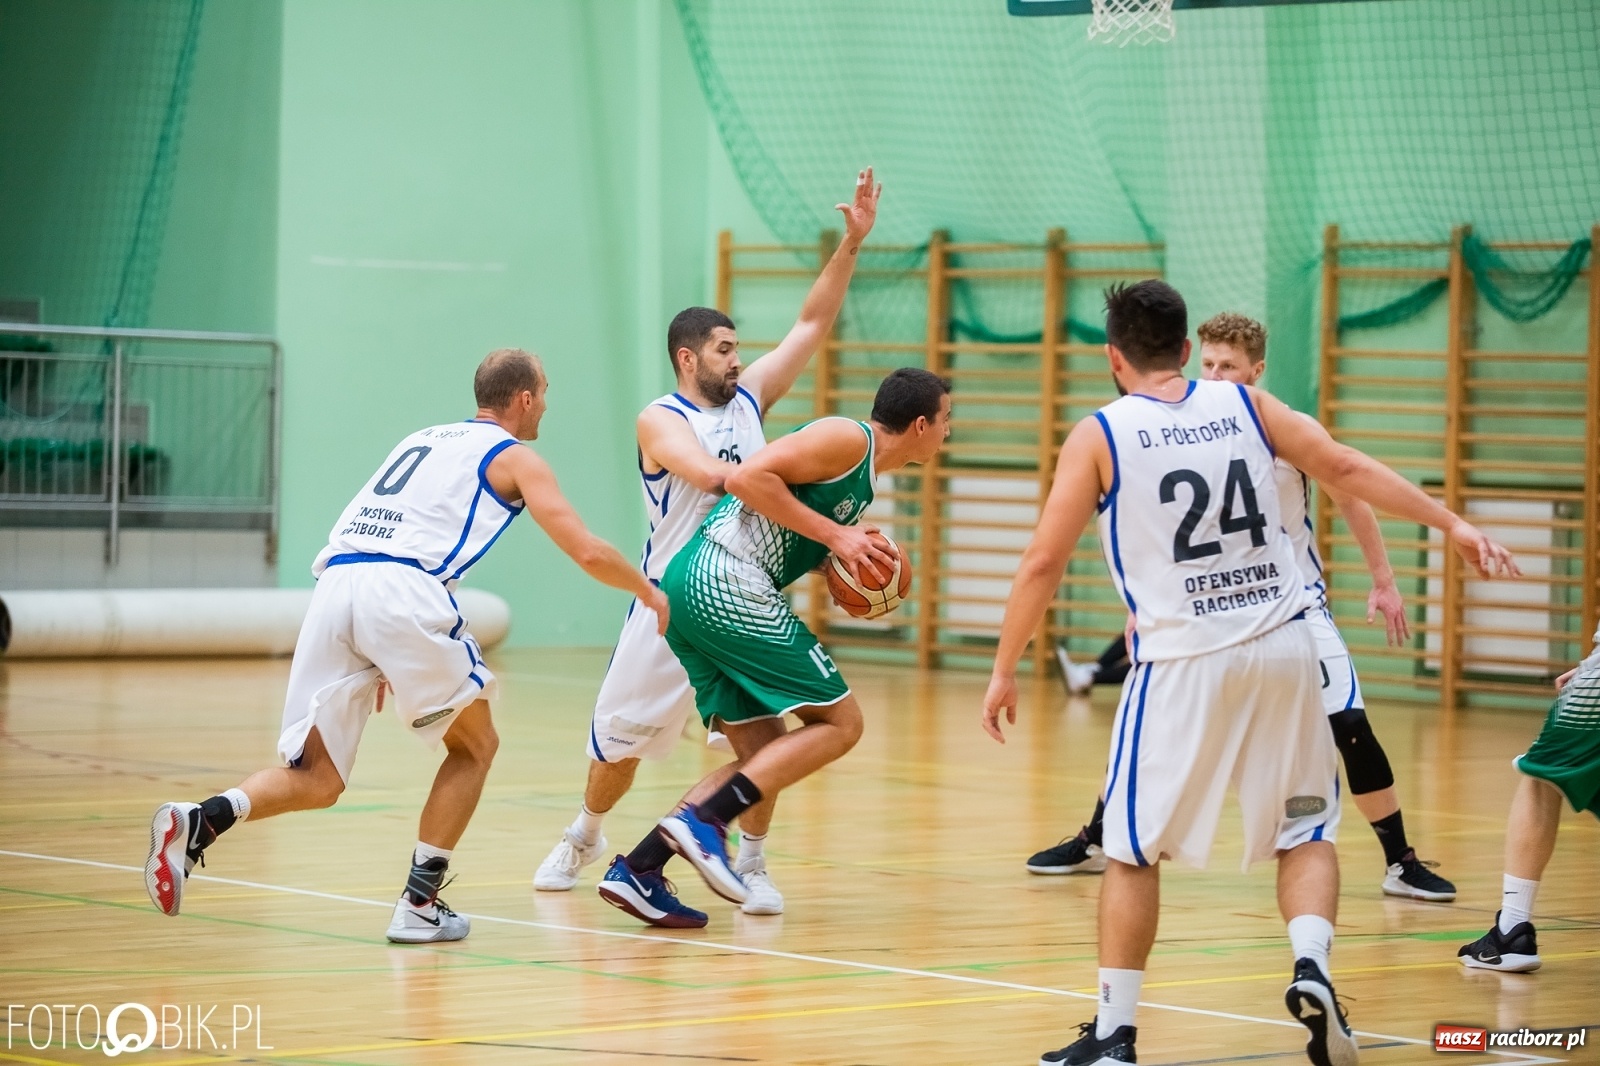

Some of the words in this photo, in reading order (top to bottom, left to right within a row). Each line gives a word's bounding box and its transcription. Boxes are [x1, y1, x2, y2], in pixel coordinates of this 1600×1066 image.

[1137, 430, 1159, 449] D.
[1161, 416, 1243, 446] PÓŁTORAK
[373, 445, 433, 496] 0
[357, 506, 404, 523] NSYWA
[1159, 458, 1268, 563] 24
[340, 521, 396, 540] IBÓRZ
[1185, 562, 1280, 594] OFENSYWA
[1192, 585, 1283, 616] RACIBÓRZ
[808, 641, 838, 679] 15
